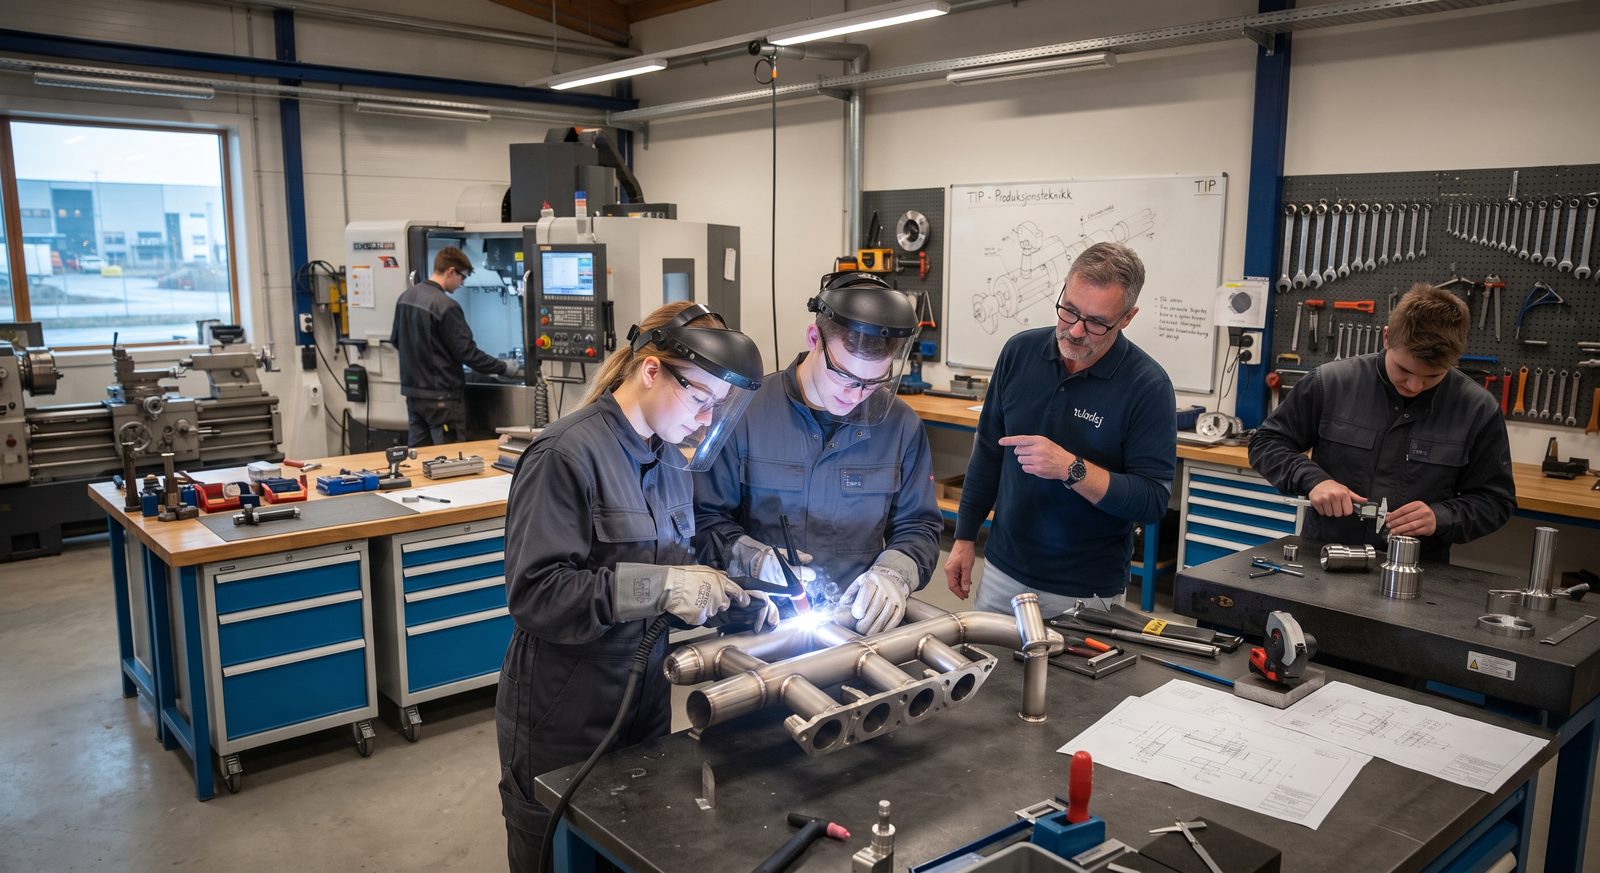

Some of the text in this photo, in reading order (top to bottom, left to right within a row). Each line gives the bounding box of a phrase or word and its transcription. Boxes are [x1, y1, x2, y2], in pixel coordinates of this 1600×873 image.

[1194, 179, 1217, 193] TIP
[966, 190, 985, 204] TIP
[995, 187, 1073, 207] Produksjonsteknikk
